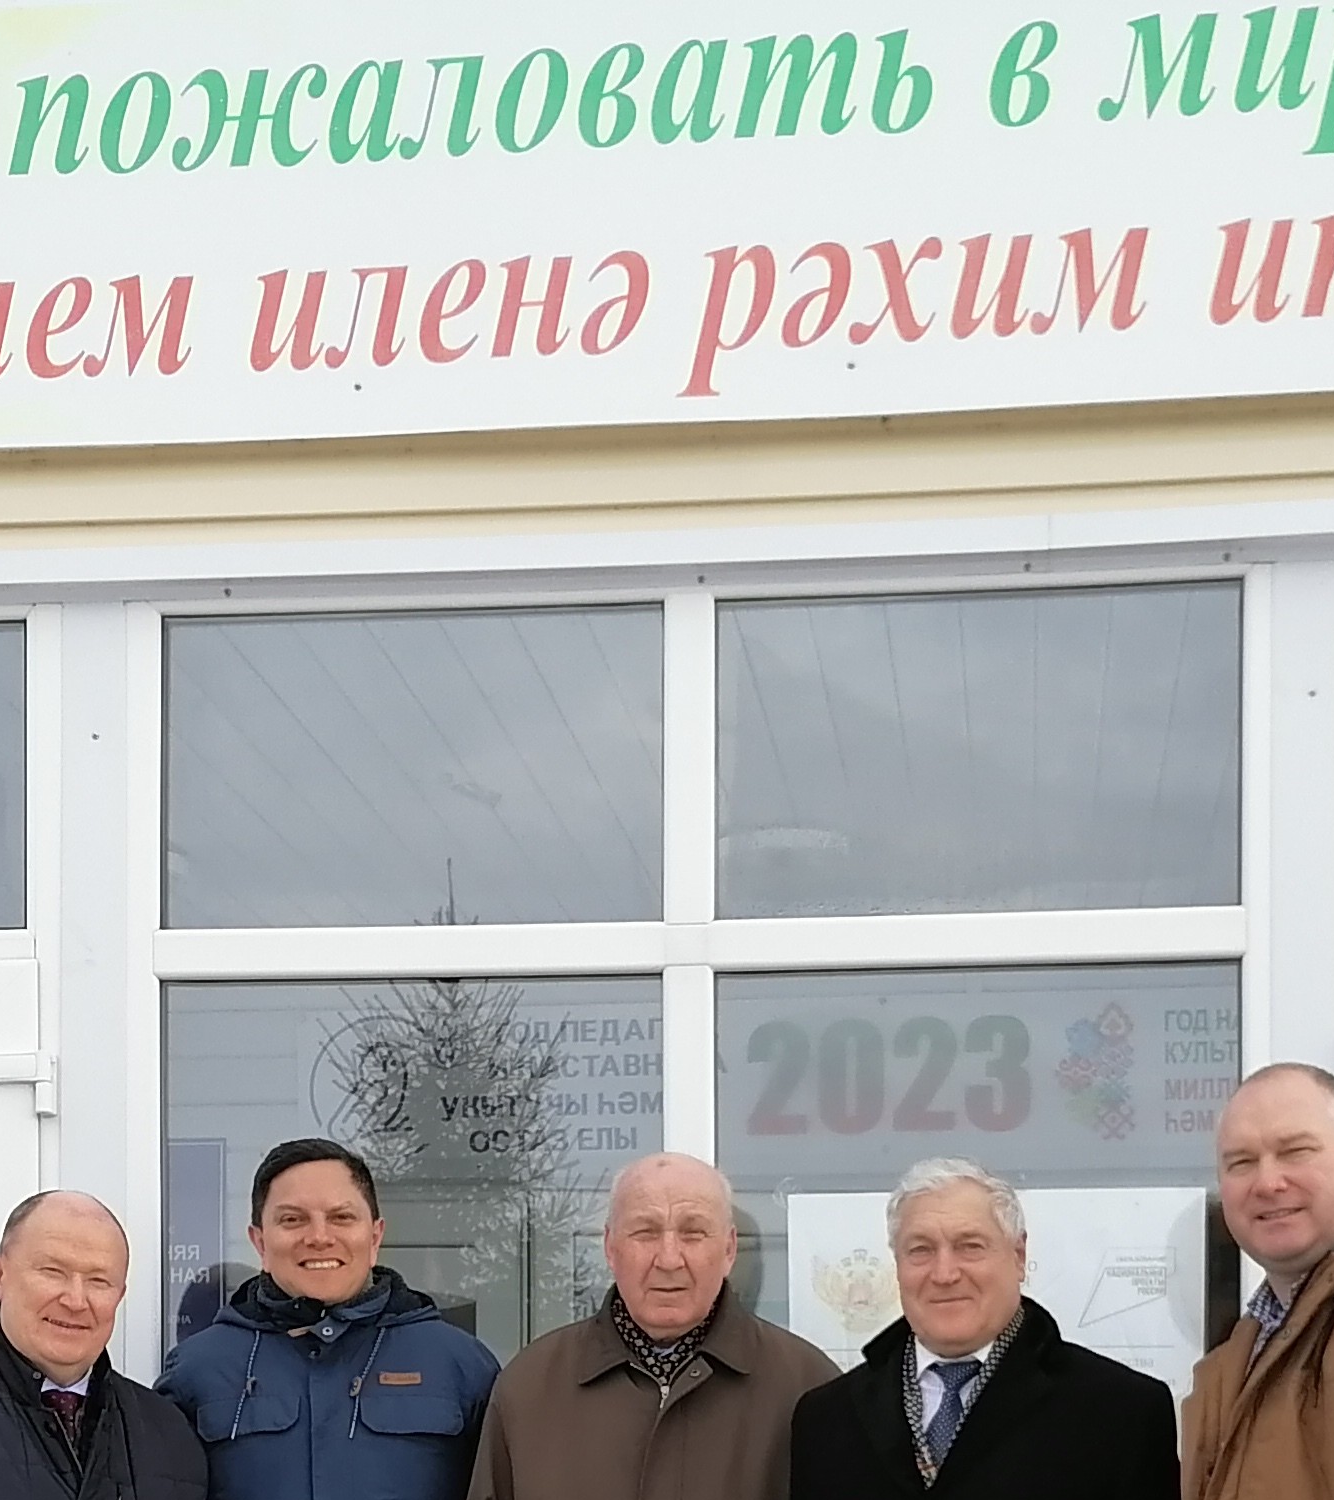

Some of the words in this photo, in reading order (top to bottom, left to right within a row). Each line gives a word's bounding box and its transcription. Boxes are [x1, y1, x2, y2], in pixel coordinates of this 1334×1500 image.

[8, 31, 934, 176] пожаловать
[989, 20, 1055, 127] в
[249, 250, 650, 371] иленә
[677, 225, 1147, 397] рәхим
[495, 1019, 551, 1046] ОД
[1164, 1008, 1210, 1036] ГОД
[746, 1015, 1032, 1135] 2023
[1165, 1077, 1238, 1102] МИЛЛ
[440, 1091, 589, 1121] УКЫТЧЫ
[469, 1129, 569, 1153] ОСТЗ
